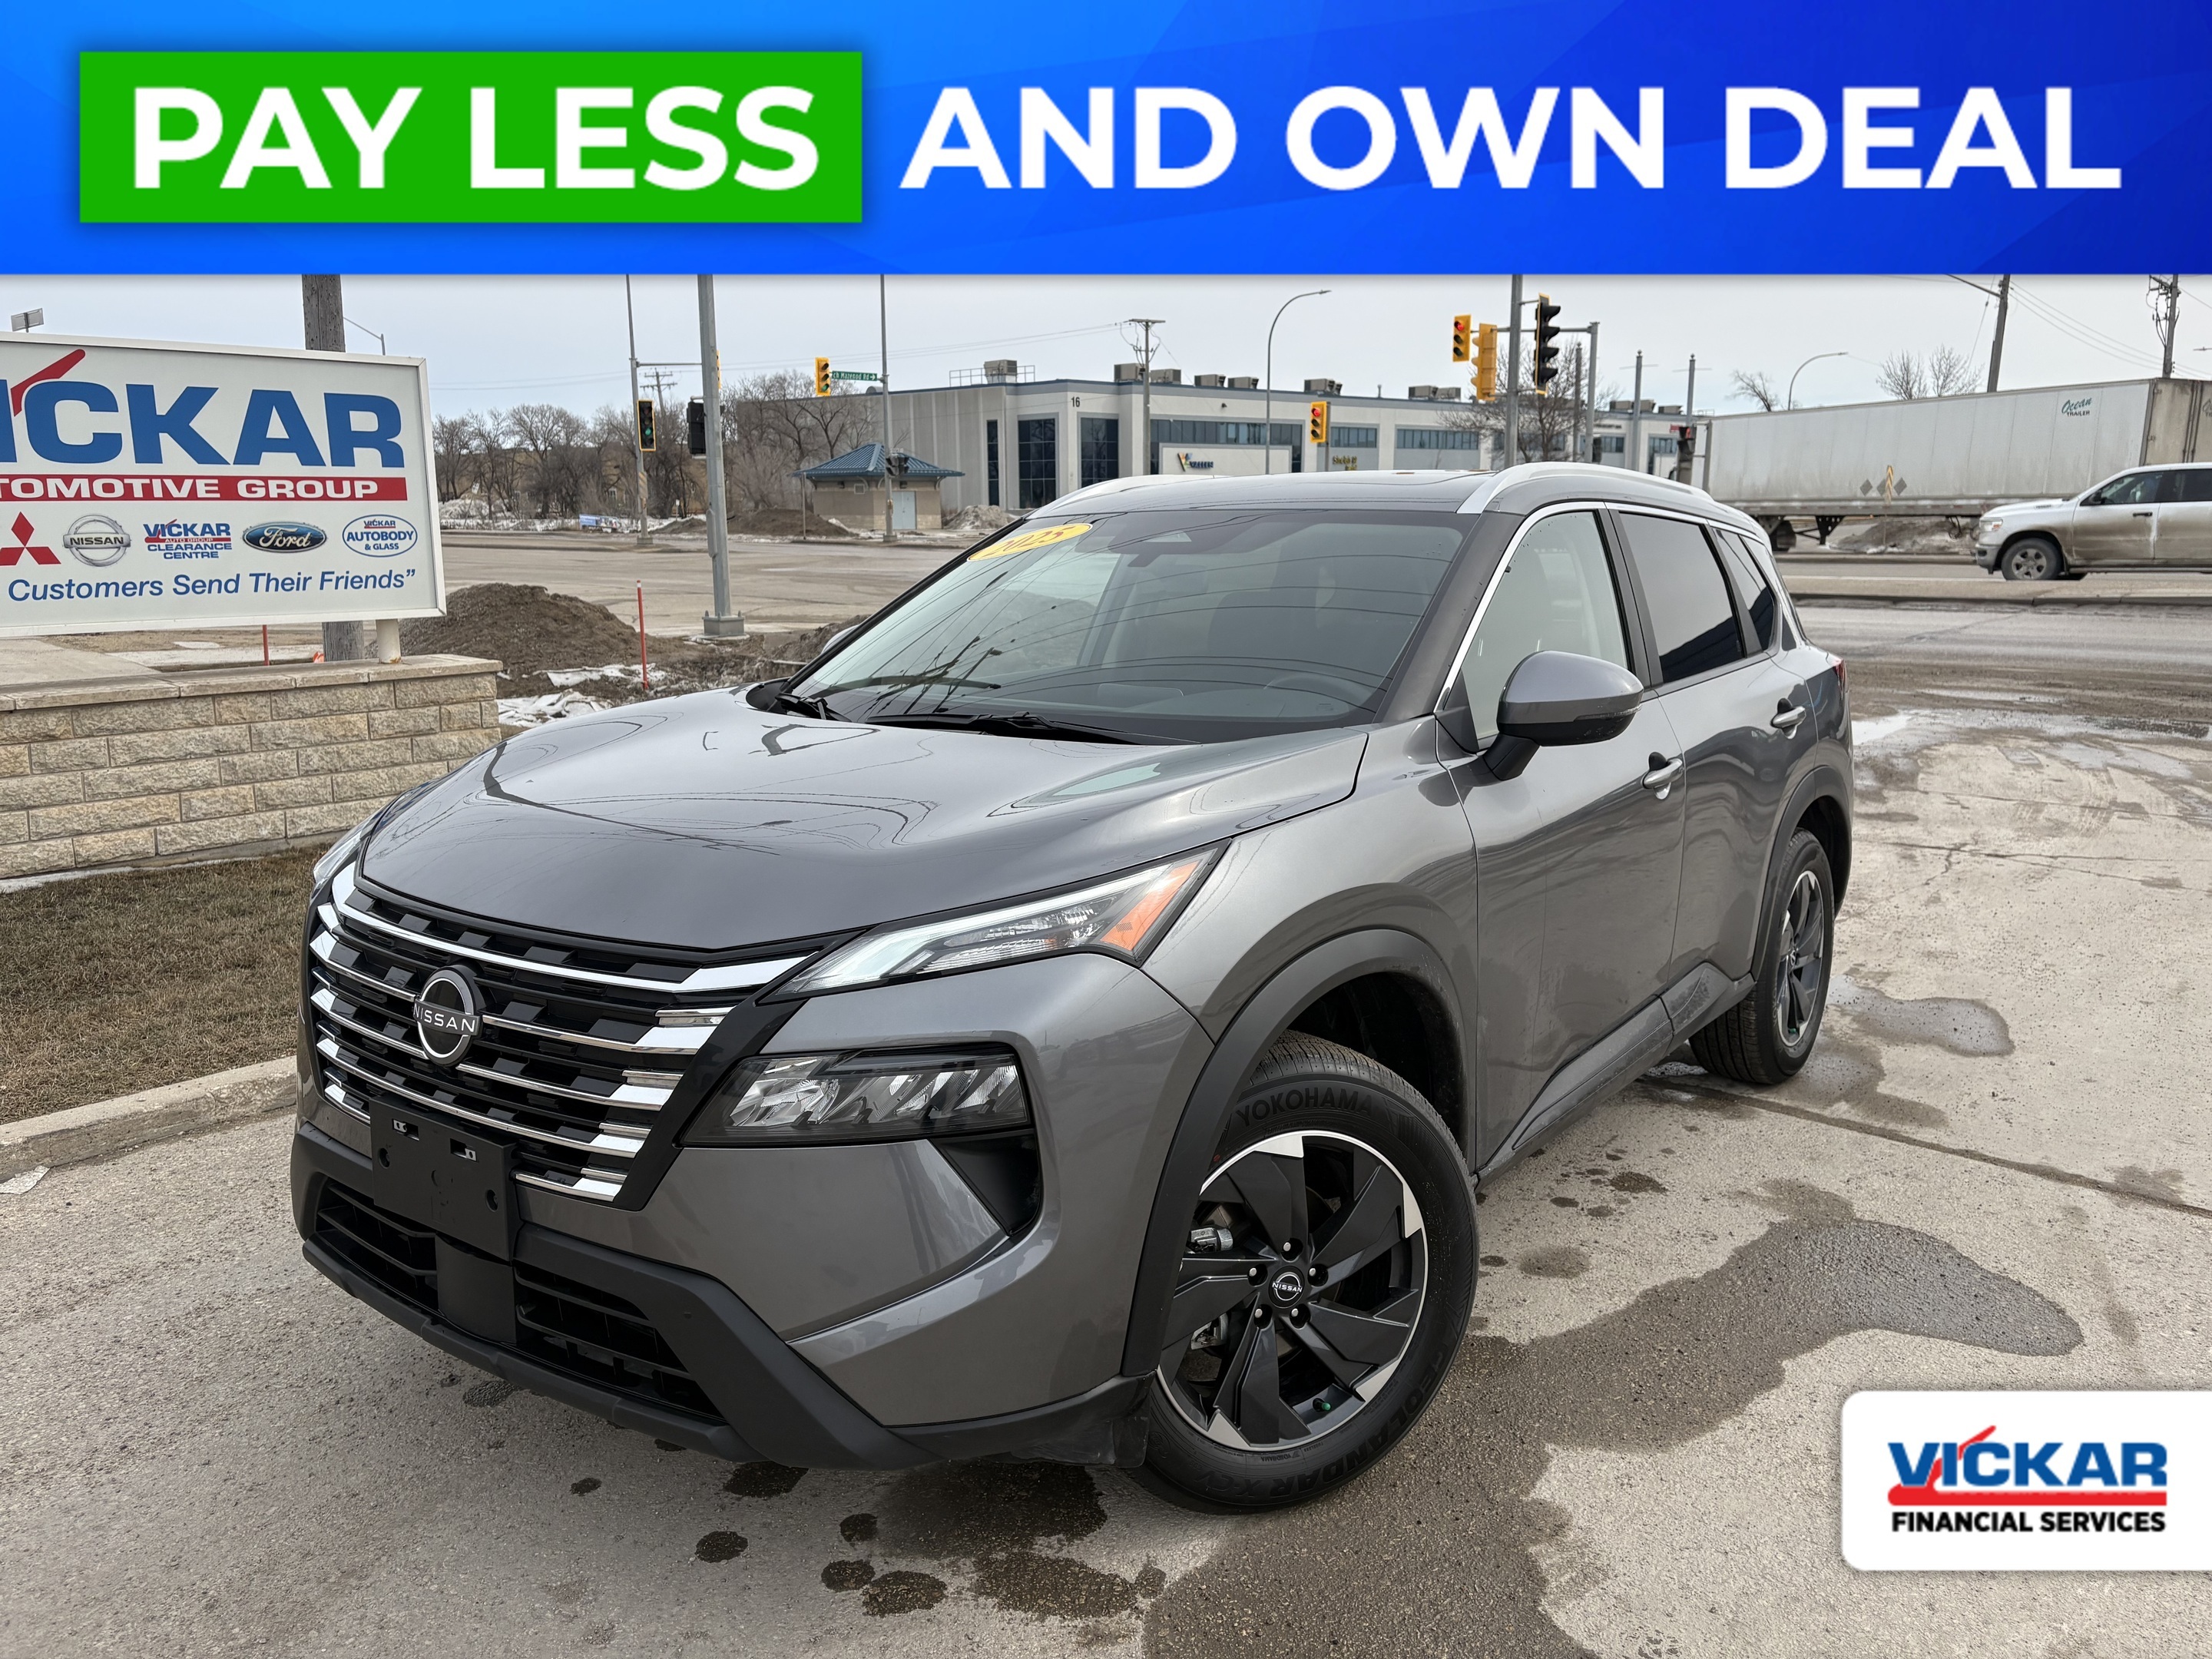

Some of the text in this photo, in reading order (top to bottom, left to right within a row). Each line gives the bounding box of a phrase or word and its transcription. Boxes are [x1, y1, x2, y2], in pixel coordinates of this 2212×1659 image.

[1071, 396, 1080, 408] 16
[2061, 398, 2092, 414] Ocean
[237, 478, 379, 499] GROUP
[143, 523, 231, 538] VICKAR
[259, 526, 311, 548] Ford
[346, 530, 414, 542] AUTOBODY
[70, 536, 124, 546] NISSAN
[147, 543, 232, 551] CLEARANCE
[982, 525, 1076, 558] 2025
[163, 551, 219, 560] CENTRE
[8, 578, 164, 602] Customers
[172, 573, 240, 596] Send
[248, 571, 313, 593] Their
[413, 1002, 475, 1033] NISSAN
[1237, 1087, 1373, 1127] YOKOHAMA
[1272, 1282, 1303, 1293] NISSAN
